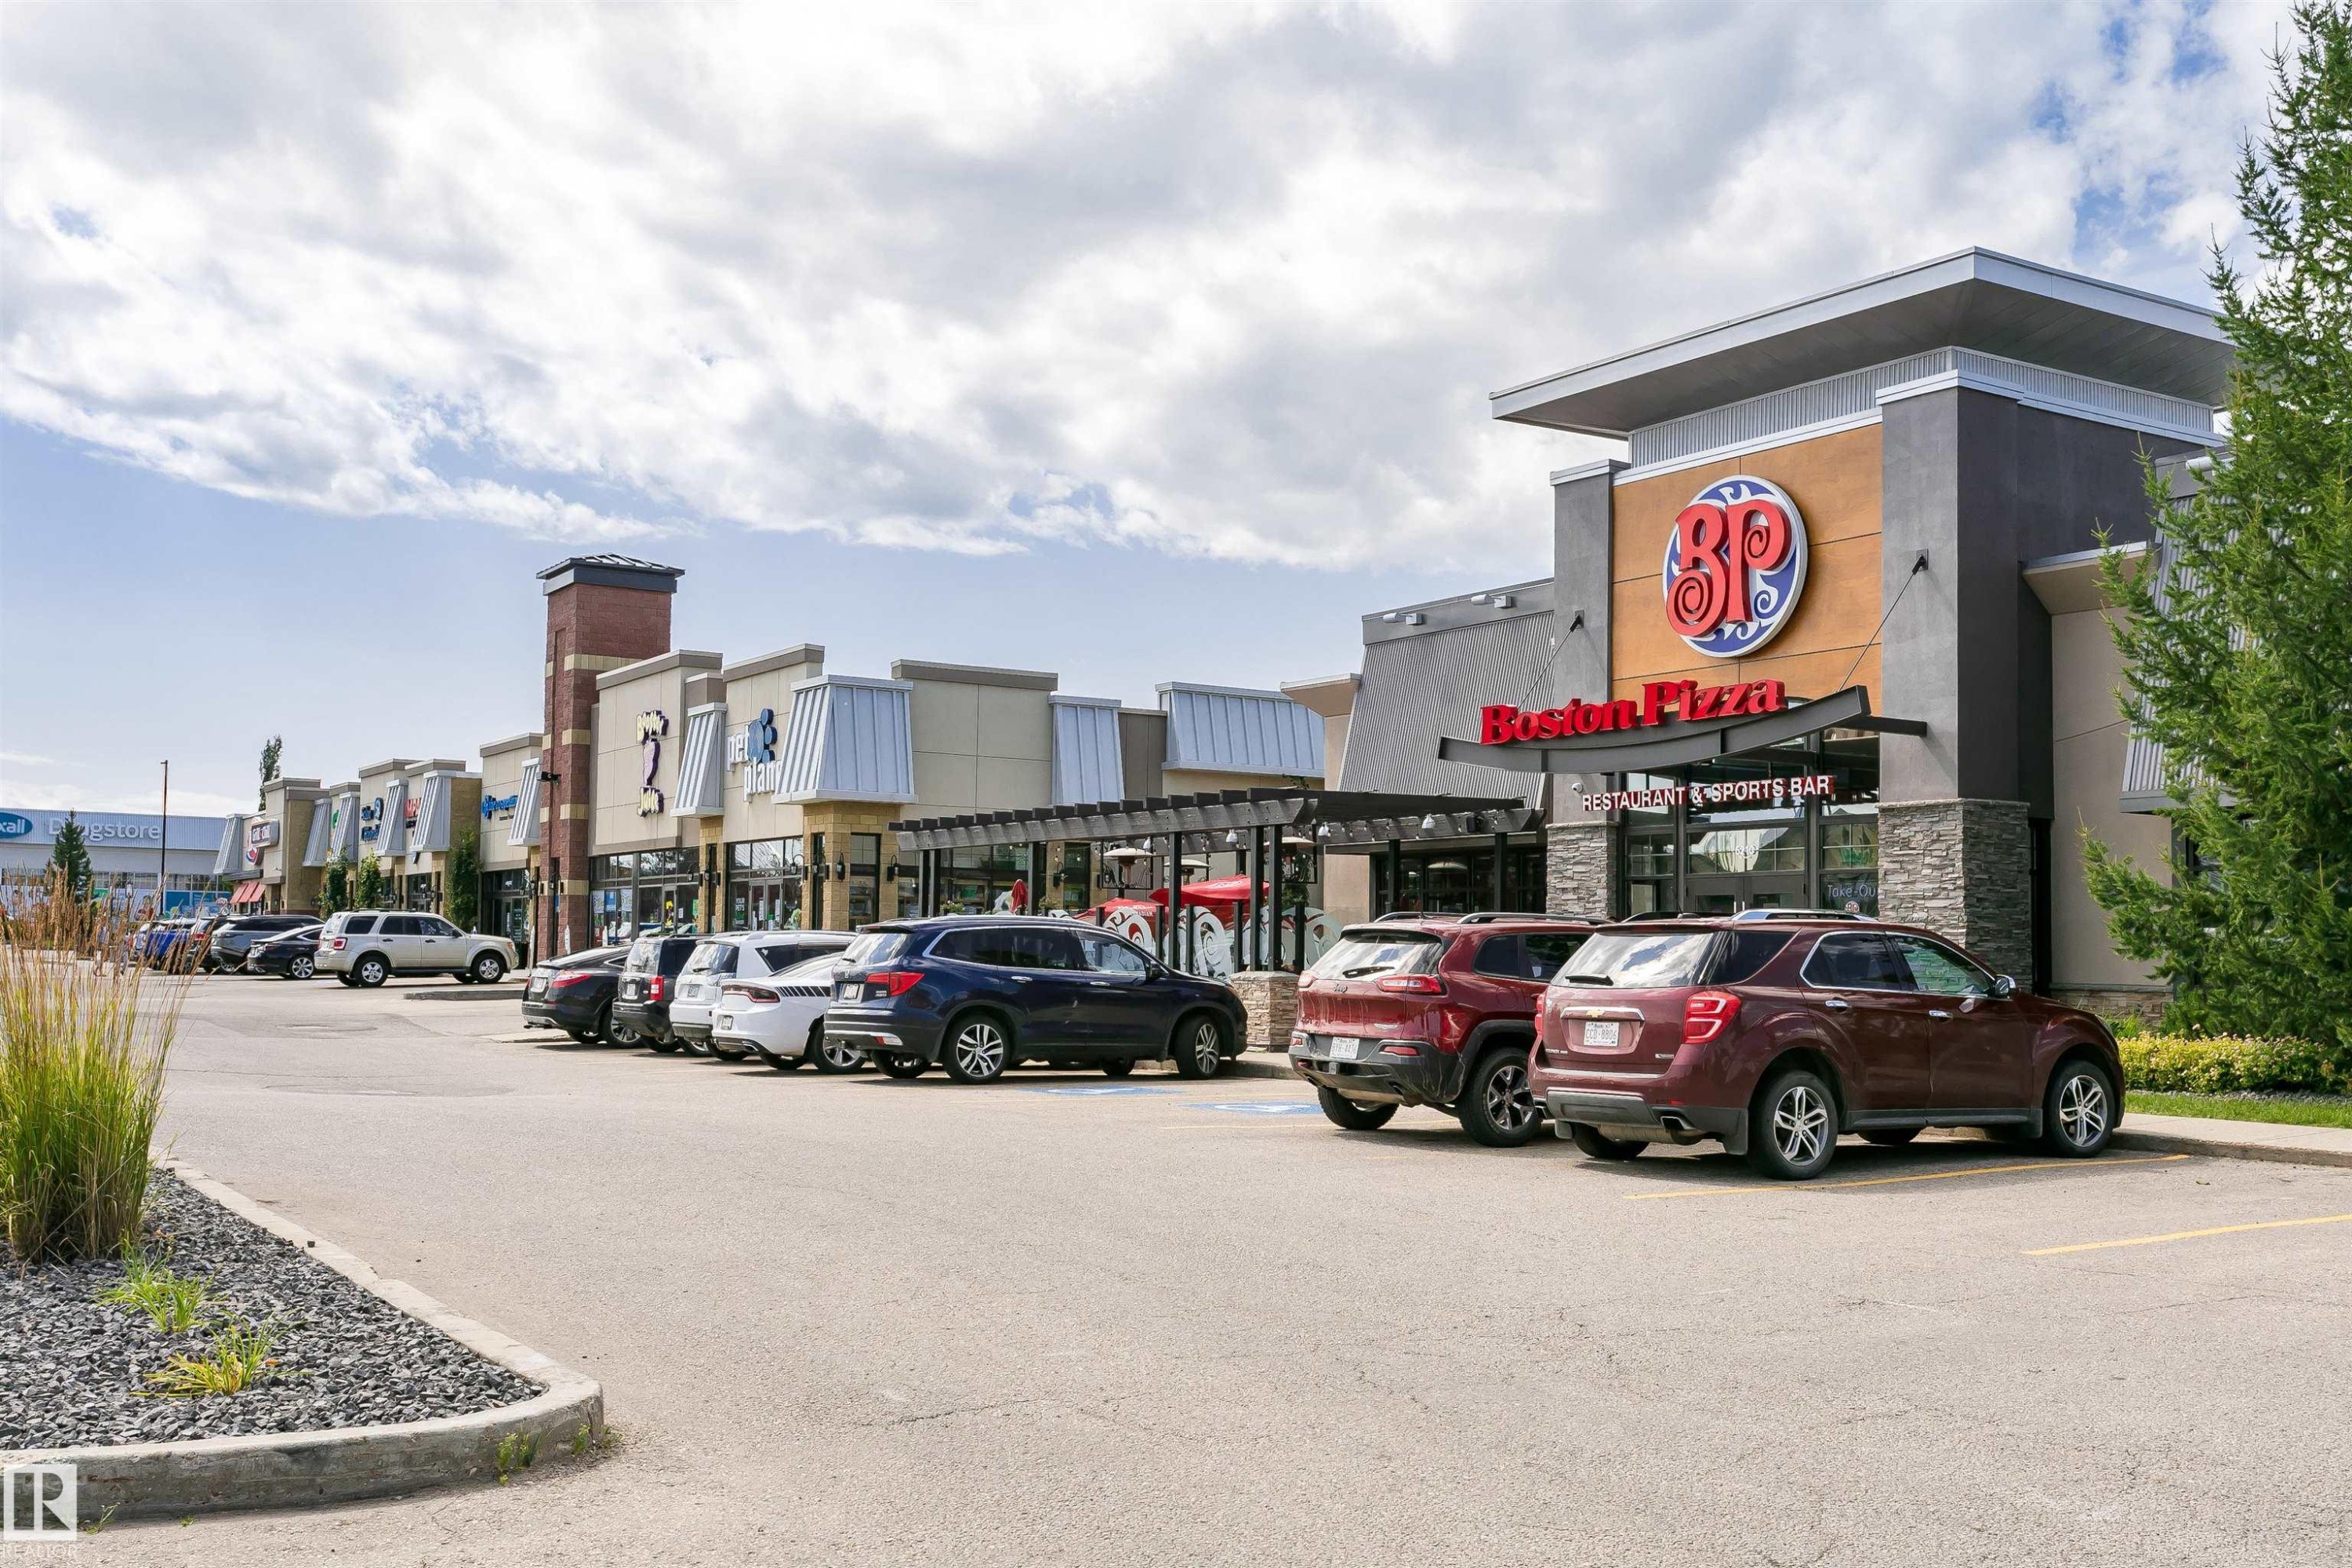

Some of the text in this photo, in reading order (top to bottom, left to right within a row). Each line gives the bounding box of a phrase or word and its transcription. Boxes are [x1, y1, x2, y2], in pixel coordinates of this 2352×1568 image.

[1666, 499, 1792, 637] BP
[637, 710, 668, 743] Booster
[1480, 679, 1785, 746] Boston Pizza
[728, 724, 750, 771] pet
[637, 786, 663, 817] Juice
[1582, 775, 1831, 811] RESTAURANT & SPORTS BAR
[0, 818, 25, 833] xall
[1828, 884, 1876, 898] Take-Ou
